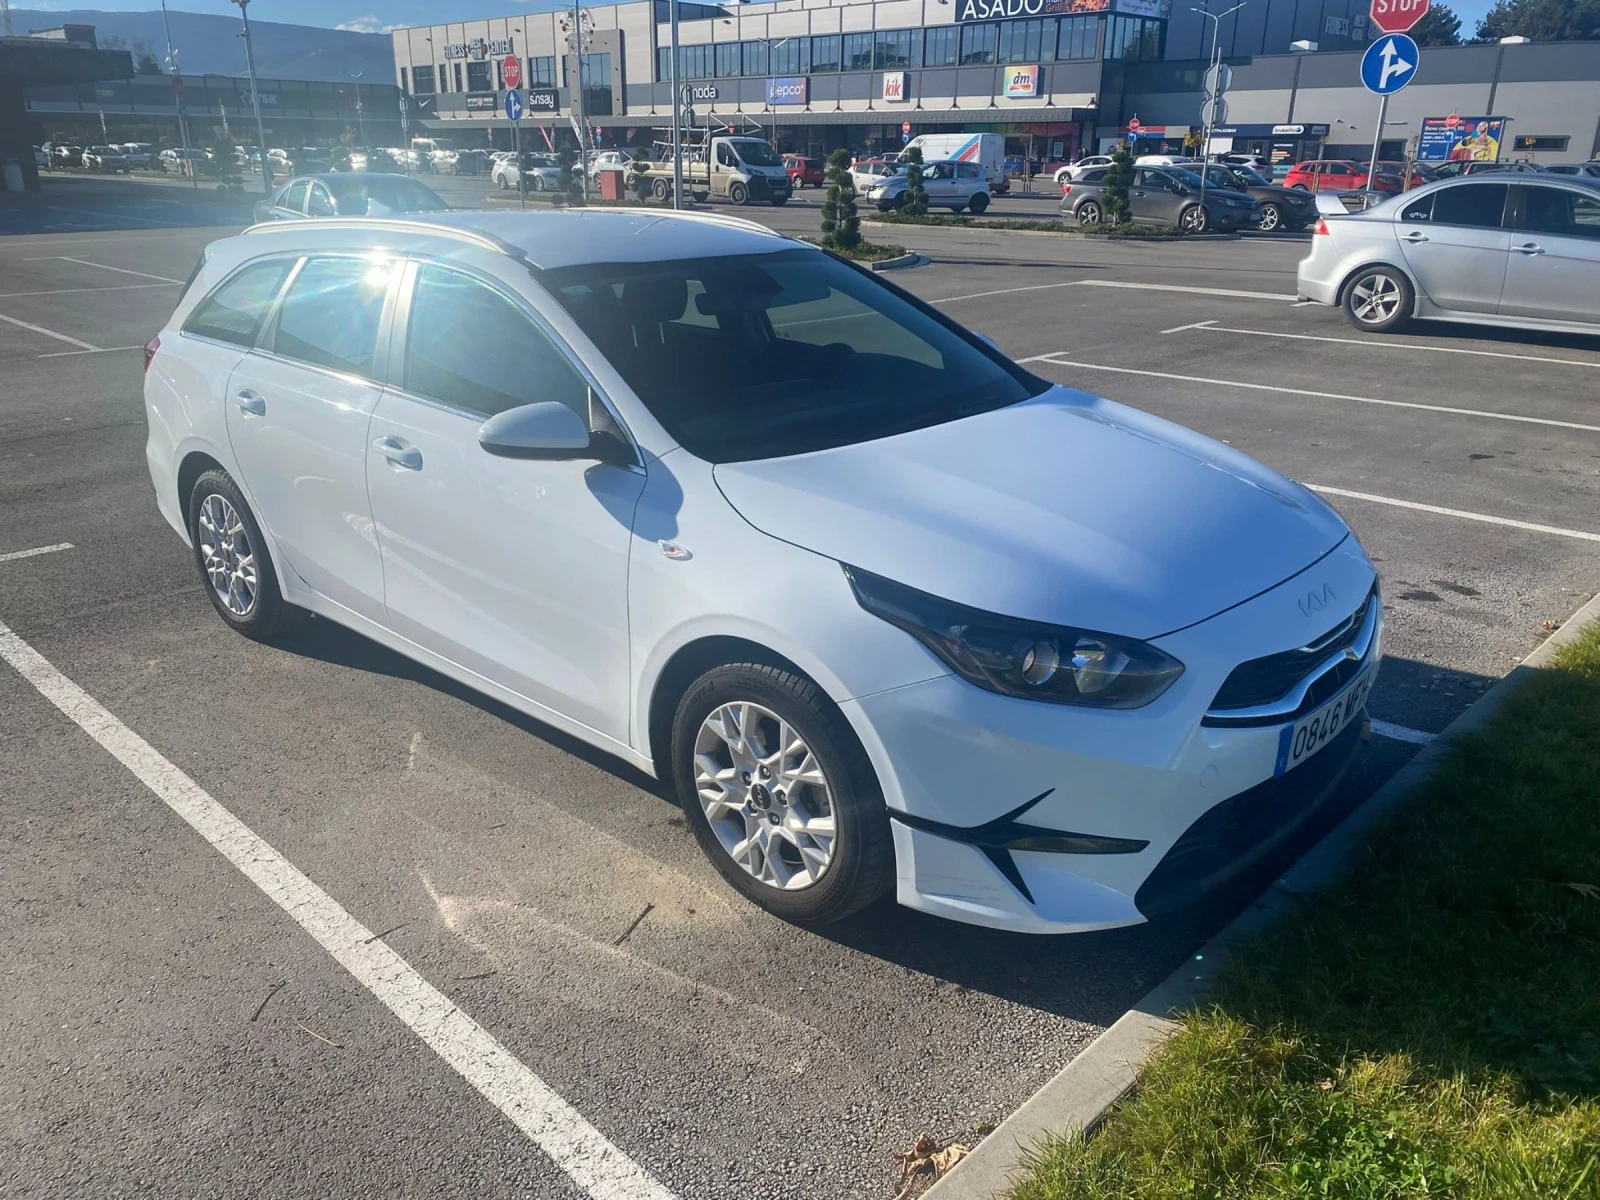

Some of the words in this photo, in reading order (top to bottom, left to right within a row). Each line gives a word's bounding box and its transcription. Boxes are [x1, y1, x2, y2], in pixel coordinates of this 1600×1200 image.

[961, 0, 1043, 19] ASADO
[1045, 3, 1062, 13] Grill
[1377, 0, 1422, 13] STOP
[444, 43, 465, 59] FITNESS
[487, 40, 512, 55] CENTER
[504, 65, 519, 78] STOP
[1013, 72, 1030, 85] dm
[770, 83, 801, 98] pepco
[529, 92, 554, 109] sinsay
[1297, 583, 1337, 618] KIA
[1293, 701, 1342, 760] 0846
